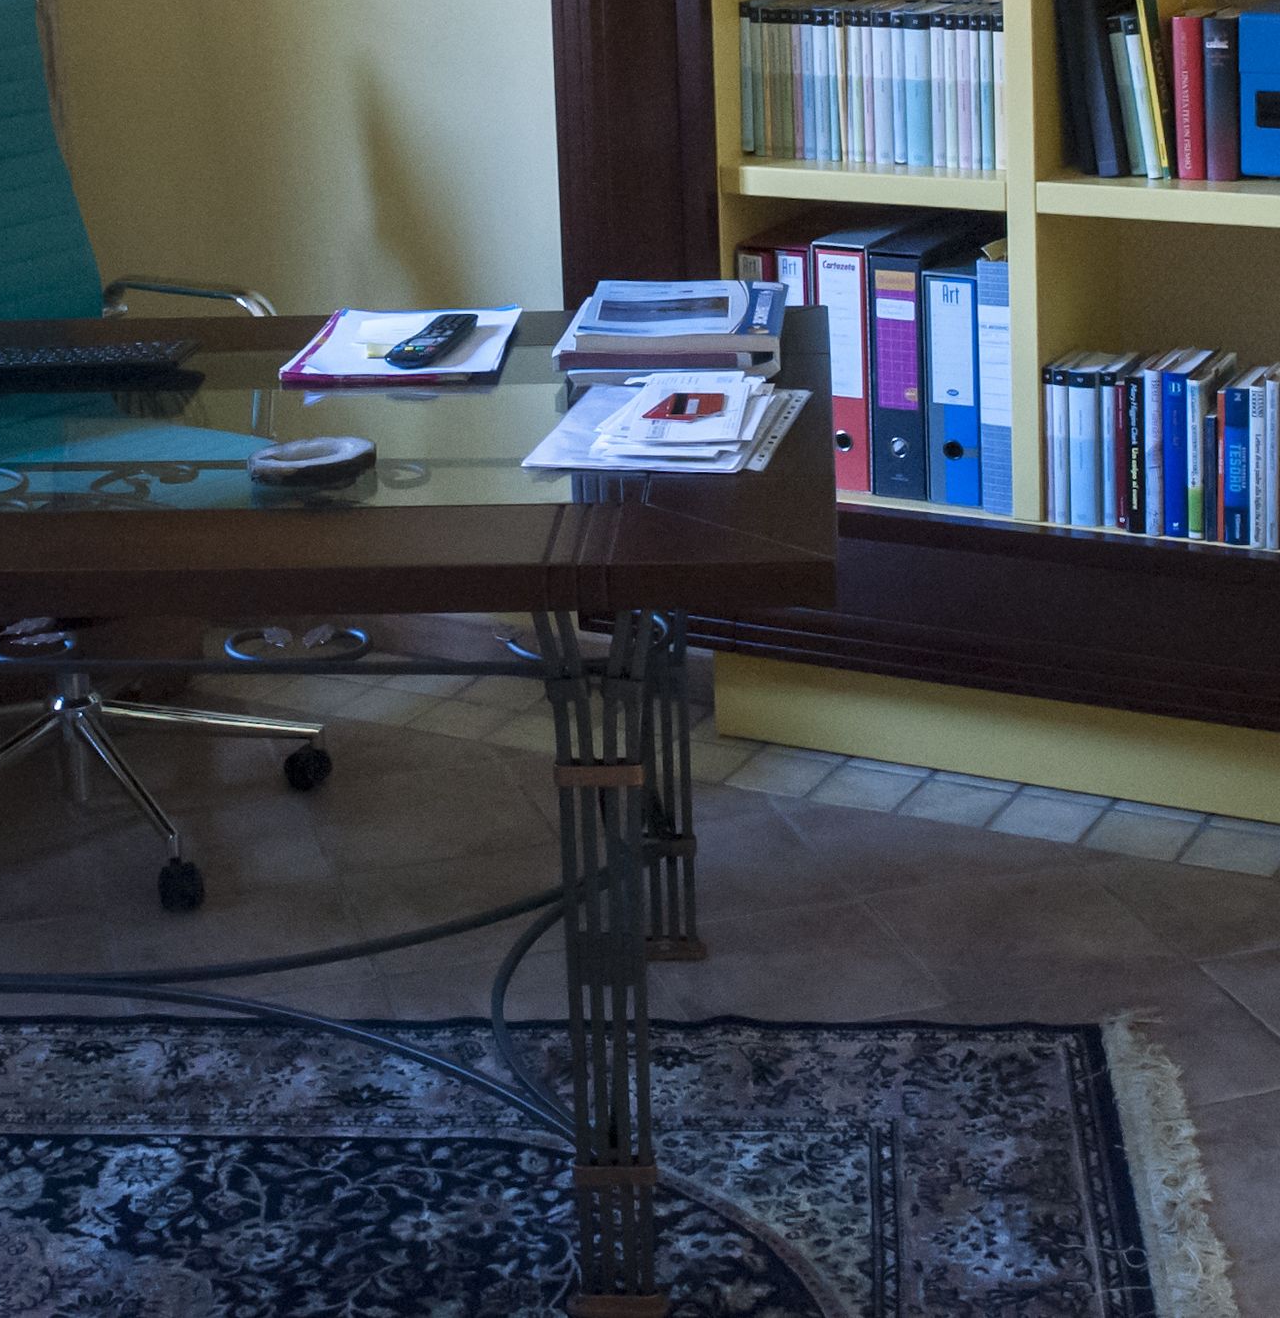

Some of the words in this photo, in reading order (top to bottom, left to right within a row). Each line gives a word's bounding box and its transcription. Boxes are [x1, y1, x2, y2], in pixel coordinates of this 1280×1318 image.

[742, 257, 758, 272] Art
[781, 258, 797, 276] Art
[942, 284, 960, 305] Art
[1129, 383, 1137, 402] Mary
[1130, 460, 1138, 479] colpo
[1229, 444, 1241, 492] TESORO
